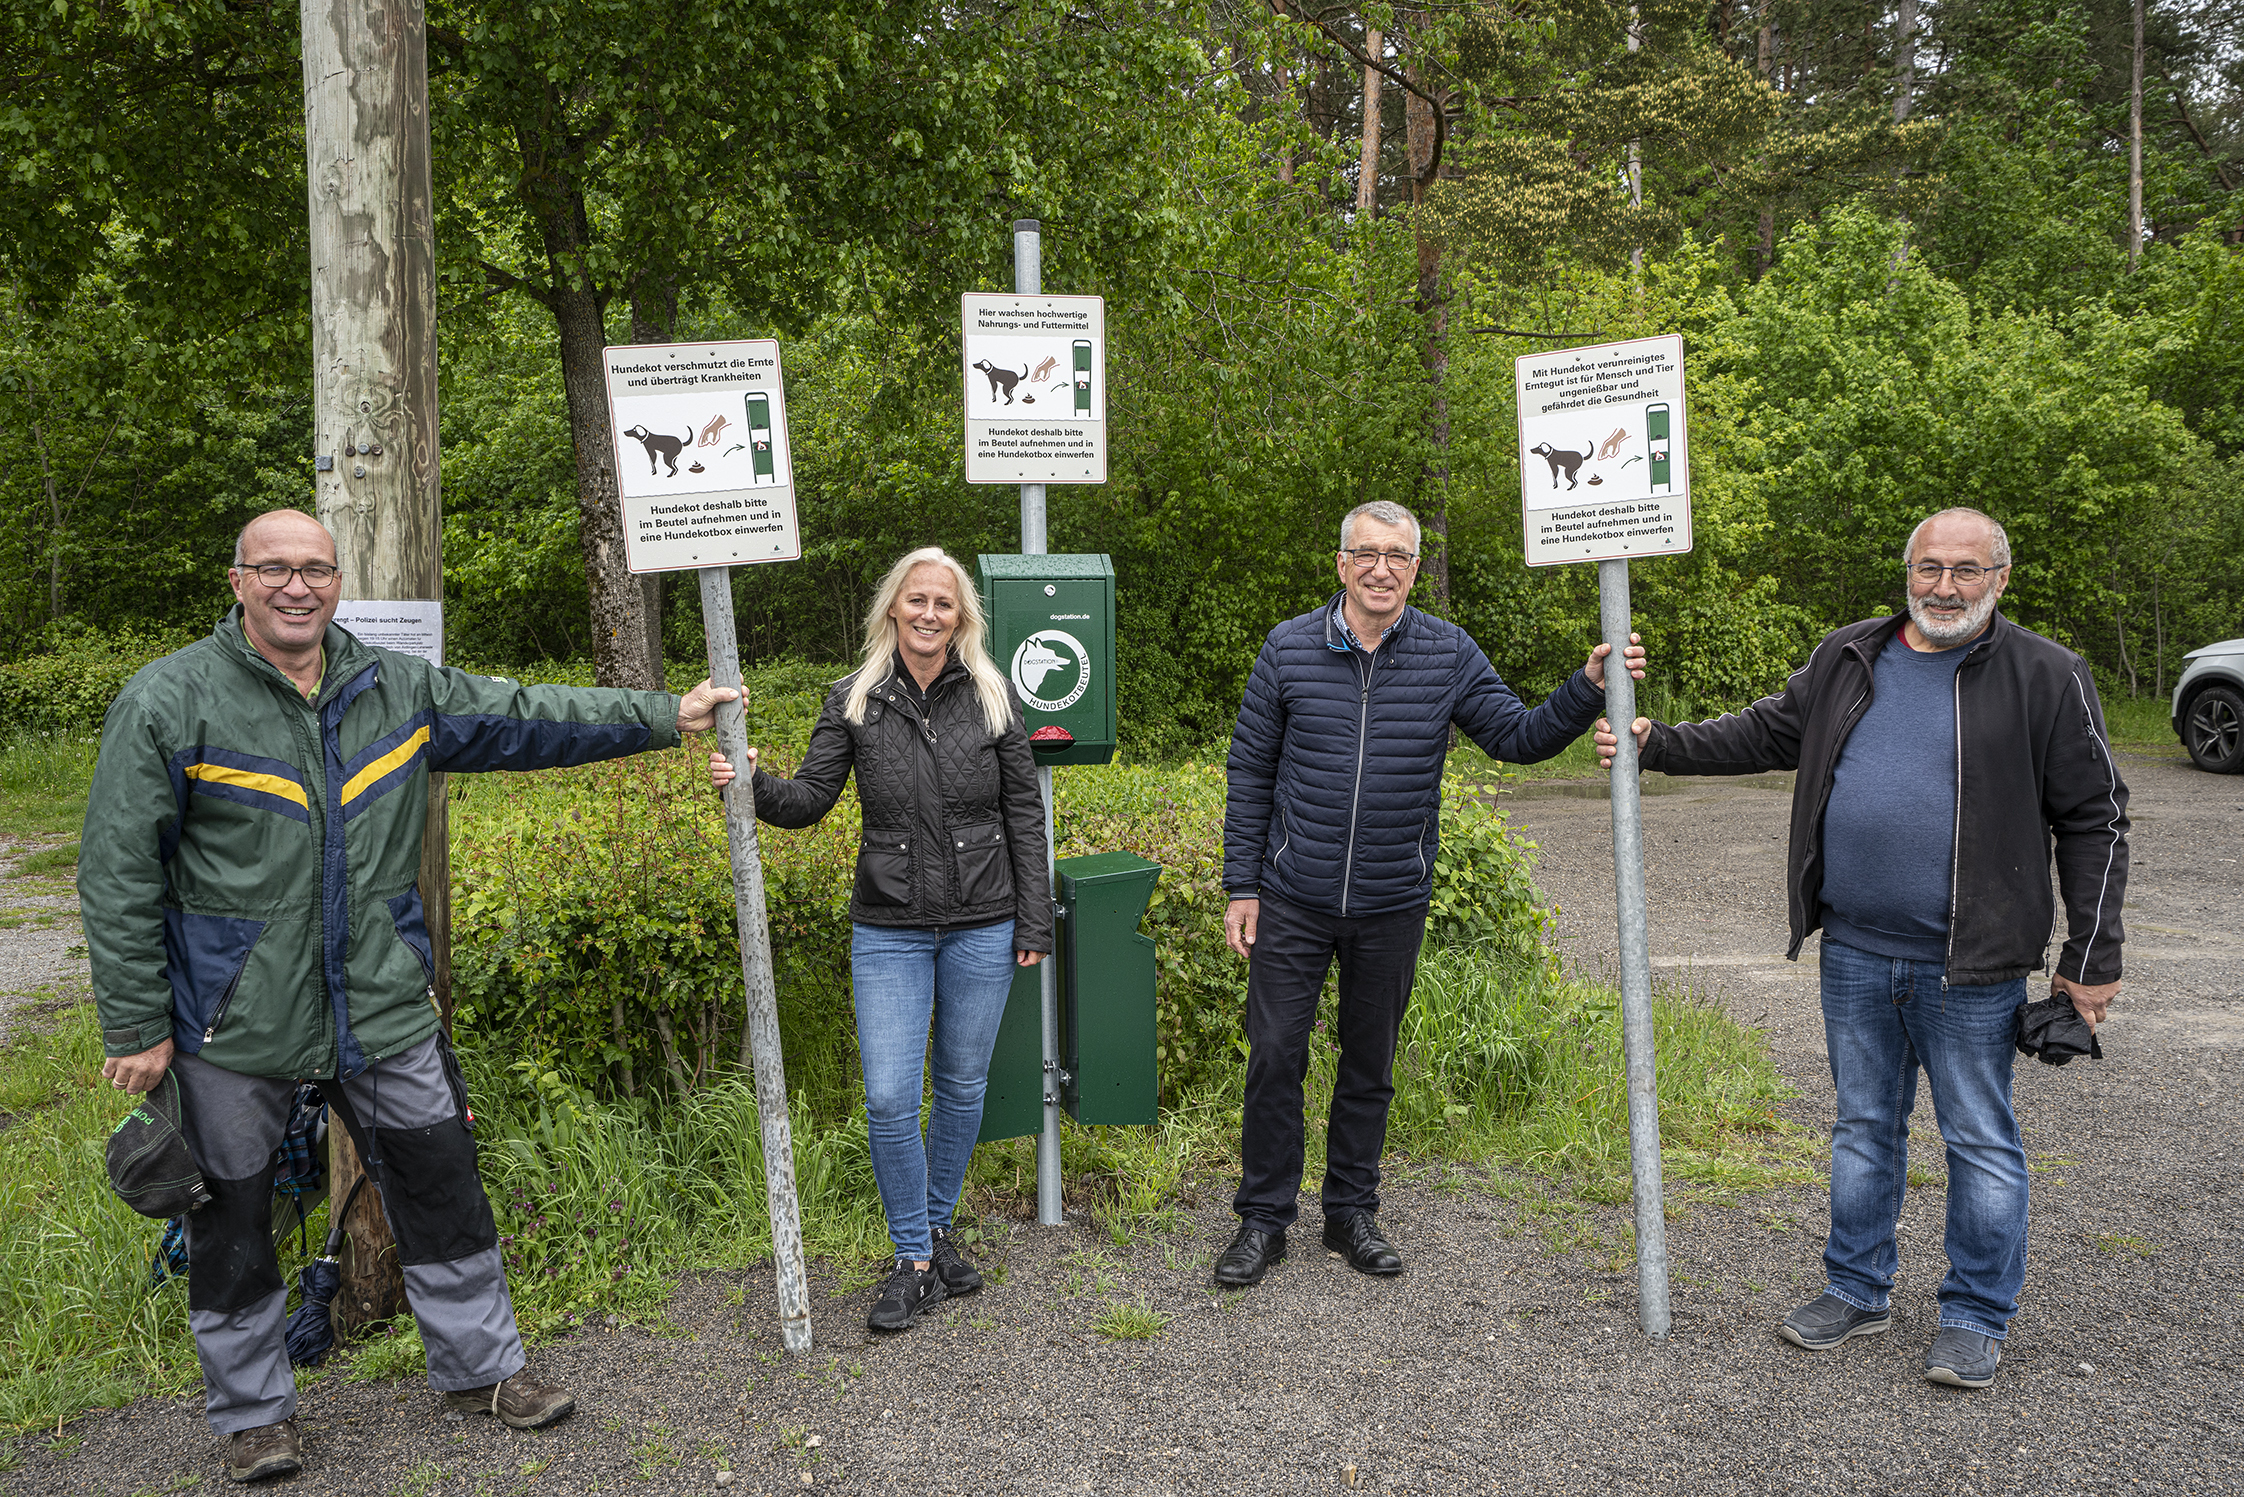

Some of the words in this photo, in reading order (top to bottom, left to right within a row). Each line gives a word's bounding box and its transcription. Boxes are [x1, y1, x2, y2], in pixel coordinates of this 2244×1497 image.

[979, 308, 996, 316] Hier
[998, 309, 1035, 317] wachsen
[1037, 309, 1087, 320] hochwertige
[978, 319, 1021, 330] Nahrungs-
[1024, 320, 1039, 329] und
[1042, 320, 1089, 330] Futtermittel
[611, 363, 662, 374] Hundekot
[664, 360, 728, 371] verschmutzt
[730, 358, 746, 368] die
[748, 357, 774, 367] Ernte
[1533, 368, 1548, 378] Mit
[1551, 362, 1595, 376] Hundekot
[1598, 353, 1665, 369] verunreinigtes
[628, 376, 648, 387] und
[651, 374, 699, 386] überträgt
[701, 371, 761, 383] Krankheiten
[1525, 378, 1564, 391] Erntegut
[1567, 376, 1578, 385] ist
[1580, 374, 1594, 383] für
[1596, 368, 1633, 381] Mensch
[1636, 365, 1654, 376] und
[1655, 363, 1674, 373] Tier
[1560, 383, 1618, 398] ungenießbar
[1621, 379, 1639, 390] und
[1542, 398, 1585, 414] gefährdet
[1588, 396, 1602, 406] die
[1604, 388, 1659, 403] Gesundheit
[989, 427, 1029, 436] Hundekot
[1031, 428, 1063, 436] deshalb
[1065, 428, 1083, 436] bitte
[979, 438, 989, 447] im
[992, 438, 1018, 447] Beutel
[1020, 439, 1066, 447] aufnehmen
[1068, 439, 1084, 447] und
[1086, 439, 1093, 447] in
[978, 449, 996, 458] eine
[998, 450, 1052, 458] Hundekotbox
[1055, 450, 1094, 459] einwerfen
[651, 503, 700, 515] Hundekot
[703, 499, 742, 511] deshalb
[745, 498, 767, 508] bitte
[1552, 509, 1596, 521] Hundekot
[1599, 504, 1636, 516] deshalb
[1638, 503, 1660, 512] bitte
[639, 519, 653, 529] im
[656, 516, 688, 528] Beutel
[691, 513, 747, 525] aufnehmen
[750, 510, 769, 521] und
[772, 509, 781, 519] in
[1541, 525, 1553, 534] im
[1555, 521, 1584, 532] Beutel
[1587, 517, 1640, 529] aufnehmen
[1642, 513, 1661, 524] und
[1664, 512, 1672, 521] in
[640, 532, 662, 543] eine
[665, 527, 732, 540] Hundekotbox
[735, 522, 783, 535] einwerfen
[1541, 536, 1560, 545] eine
[1563, 530, 1624, 543] Hundekotbox
[1627, 524, 1674, 537] einwerfen
[1050, 613, 1090, 621] dogstation.de
[1029, 653, 1089, 710] HUNDEKOTBEUTEL
